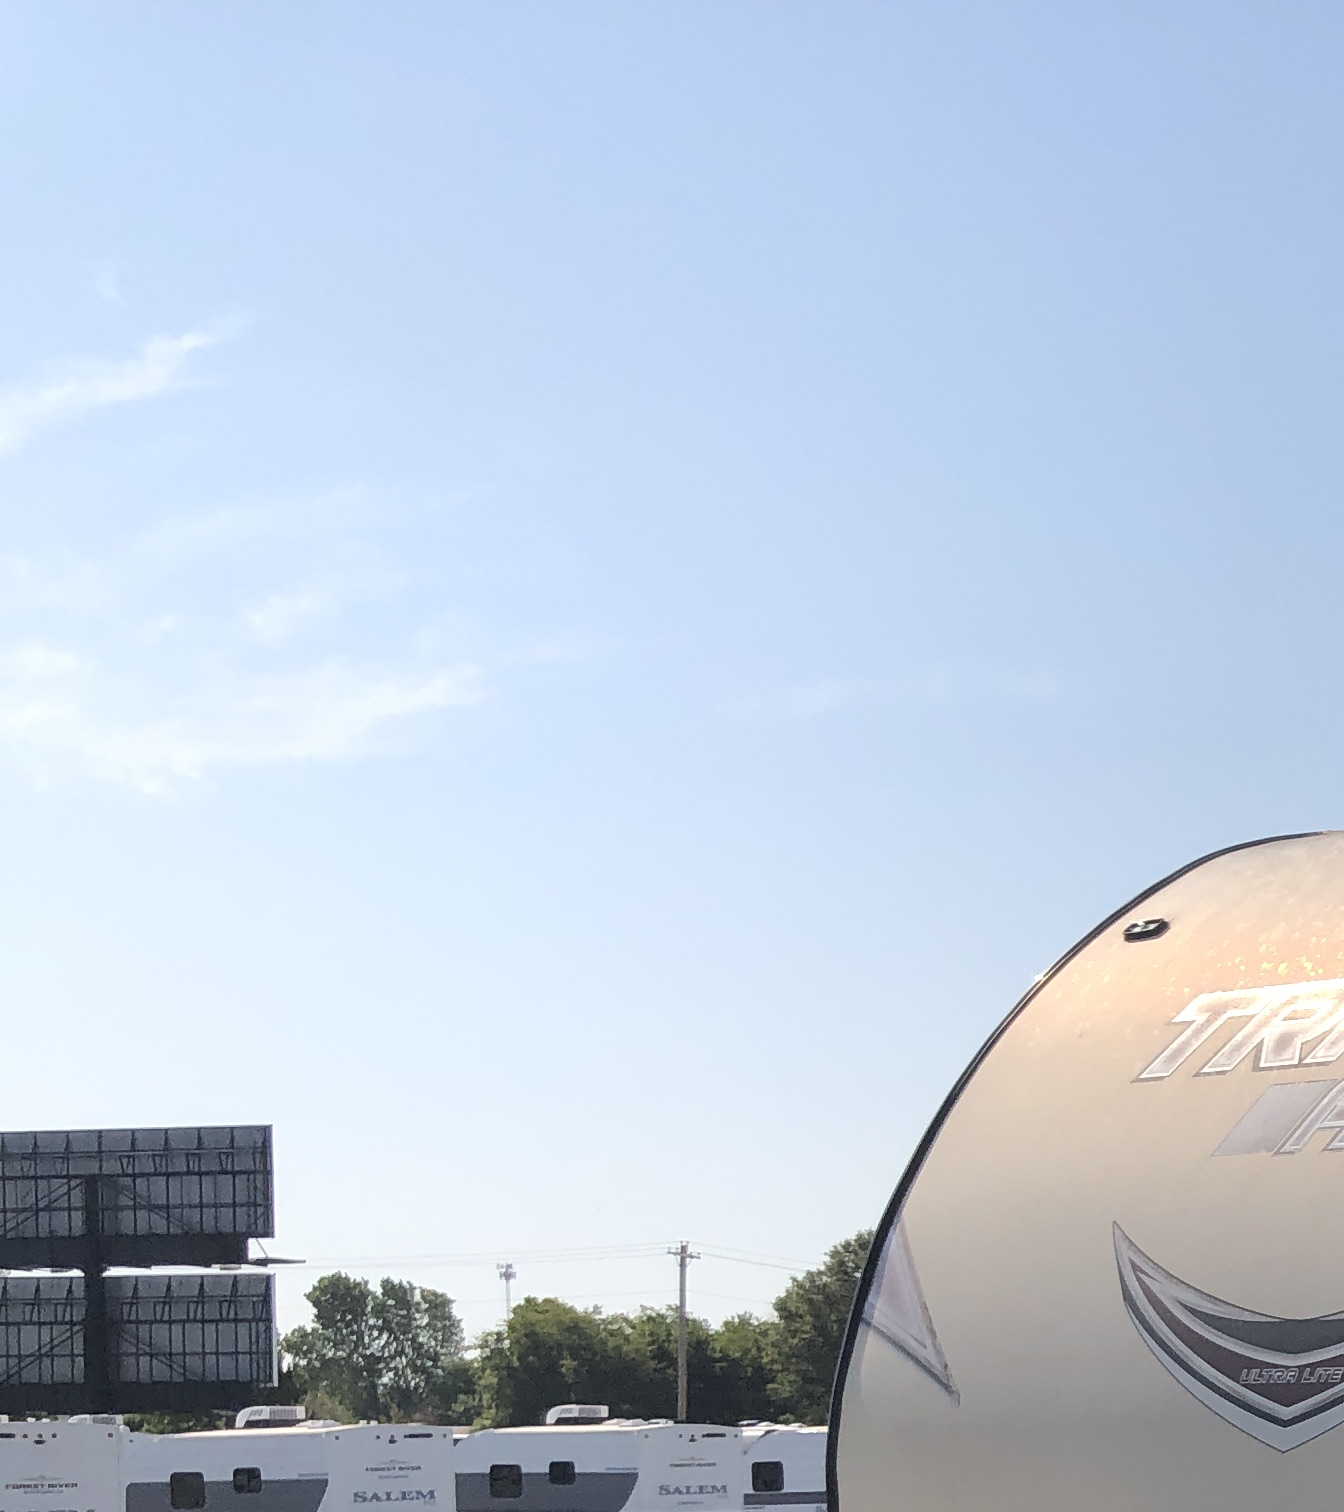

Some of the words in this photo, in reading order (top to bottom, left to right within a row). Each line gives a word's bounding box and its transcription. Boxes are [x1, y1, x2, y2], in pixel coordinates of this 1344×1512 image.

[1240, 1368, 1300, 1384] ULTRA
[352, 1489, 437, 1504] SALEM
[658, 1484, 729, 1496] SALEM
